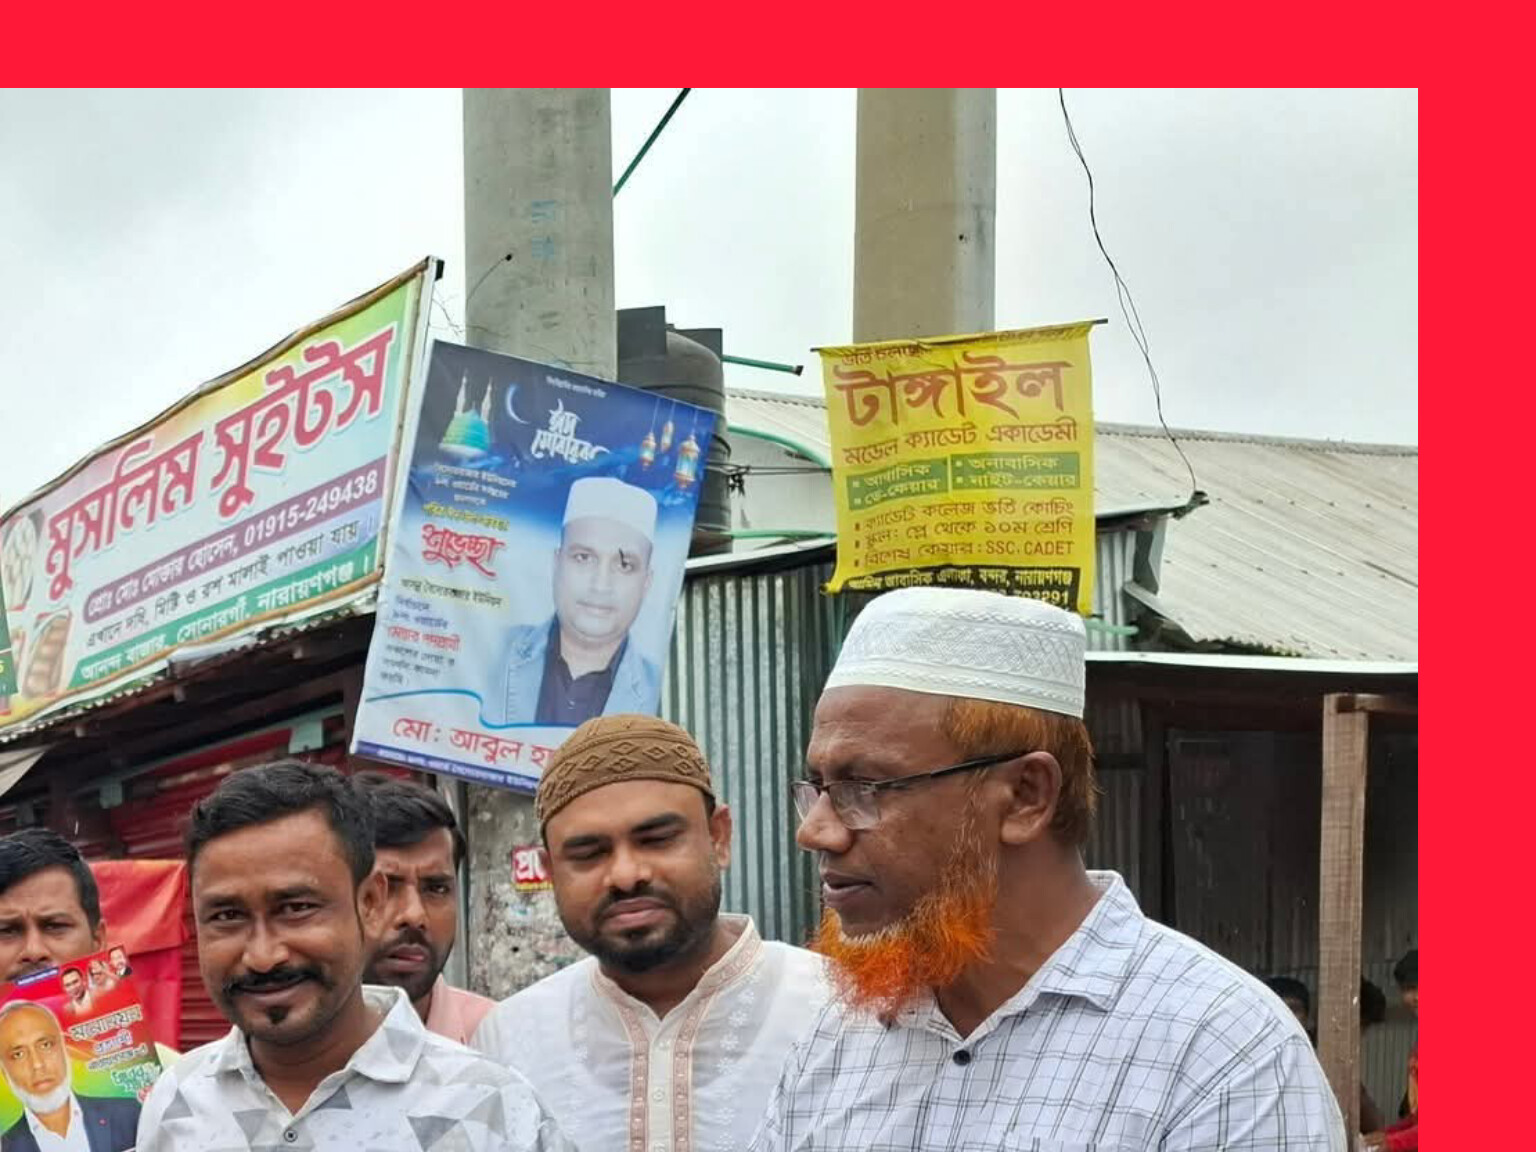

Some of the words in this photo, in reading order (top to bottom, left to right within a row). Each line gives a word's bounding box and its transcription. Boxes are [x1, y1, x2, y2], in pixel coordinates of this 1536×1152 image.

[833, 350, 1074, 426] টাঙ্গাইল
[842, 438, 898, 465] মডেল
[905, 422, 976, 449] ক্যাডেট
[986, 416, 1078, 443] একাডেমী
[45, 438, 205, 601] মুসলিম
[210, 326, 395, 518] সুইটস
[864, 463, 931, 487] আবাসিক
[967, 455, 1059, 470] অনাবাসিক
[244, 469, 378, 546] 01915-249438
[922, 503, 975, 518] কলেজ
[1023, 496, 1074, 515] কোচিং
[934, 521, 976, 536] থেকে
[1024, 541, 1075, 555] CADET
[450, 729, 524, 764] আবুল
